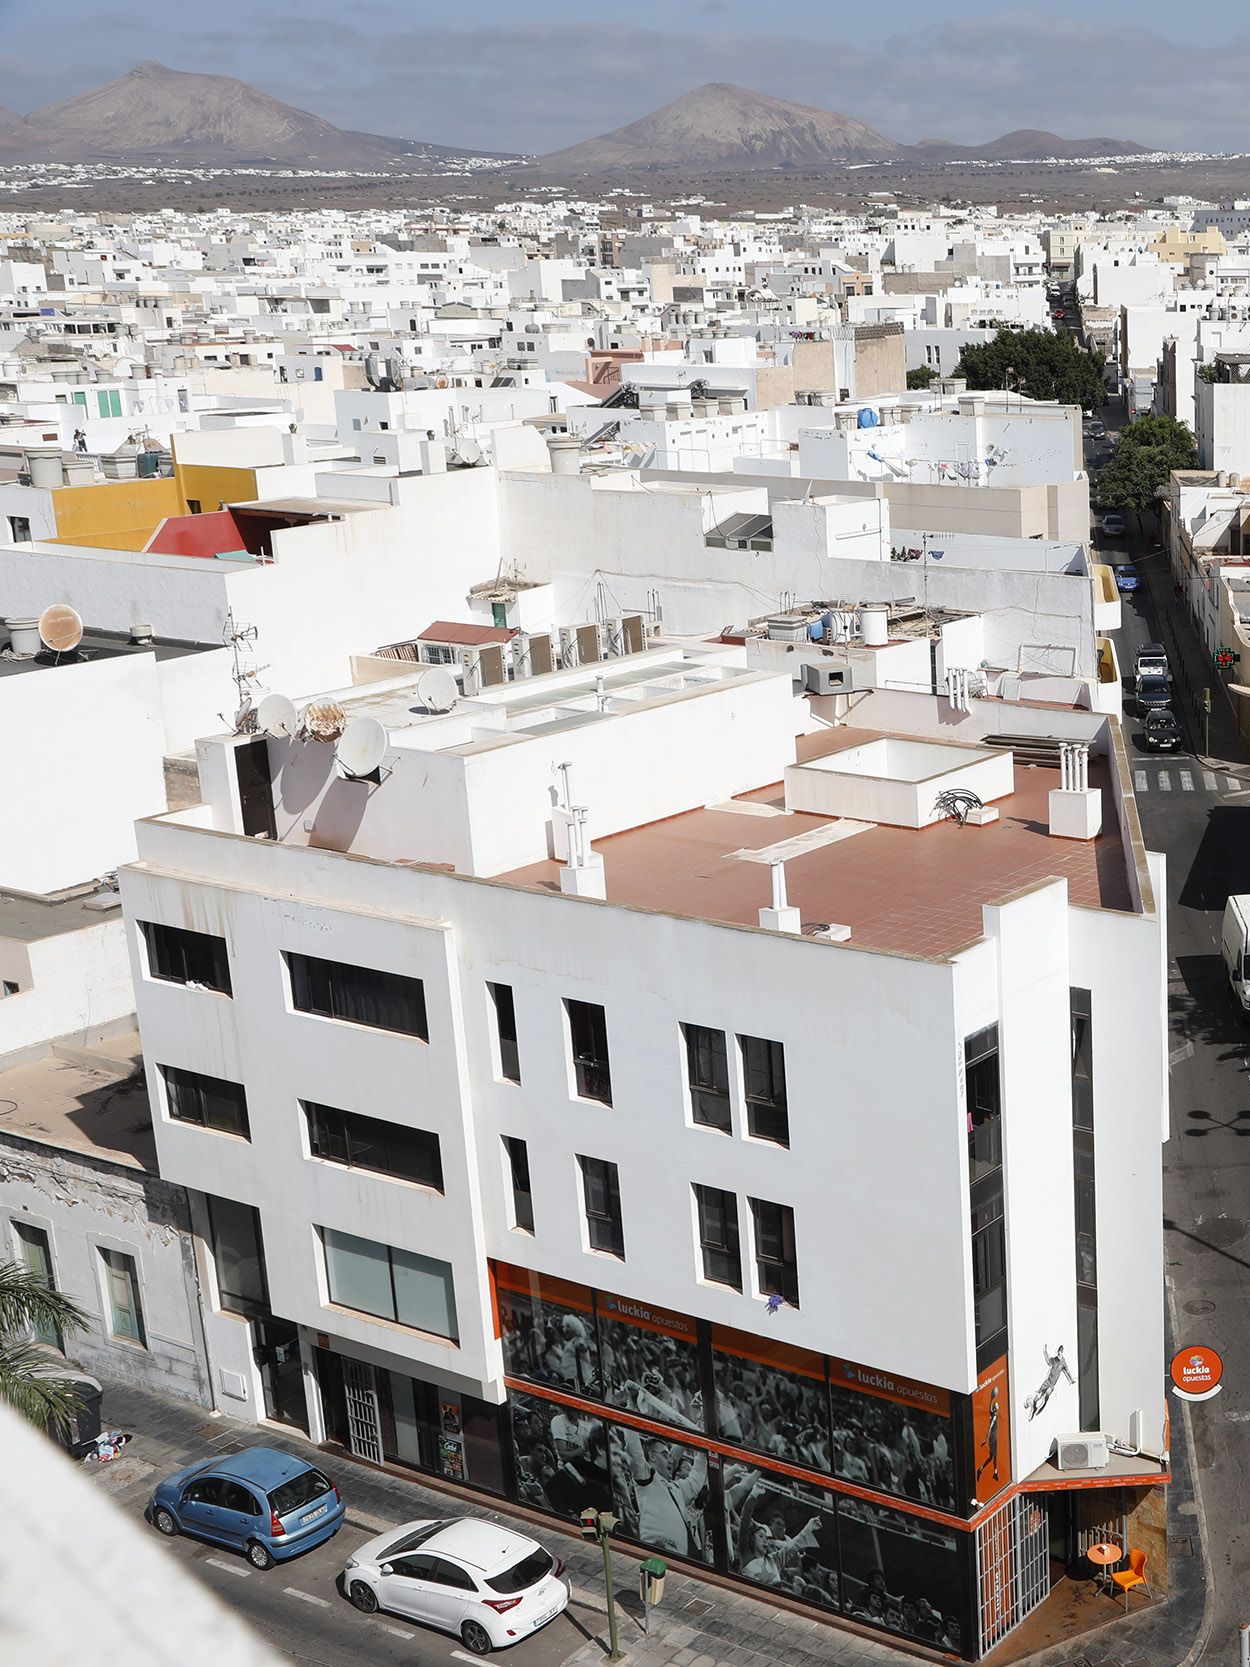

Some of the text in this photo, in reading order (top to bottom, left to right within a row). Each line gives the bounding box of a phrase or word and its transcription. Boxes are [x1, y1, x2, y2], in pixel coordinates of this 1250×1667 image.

[618, 1301, 688, 1331] luckia apuestas
[1183, 1366, 1210, 1375] luckia
[1183, 1374, 1211, 1383] apuestas
[857, 1369, 938, 1404] luckia apuestas
